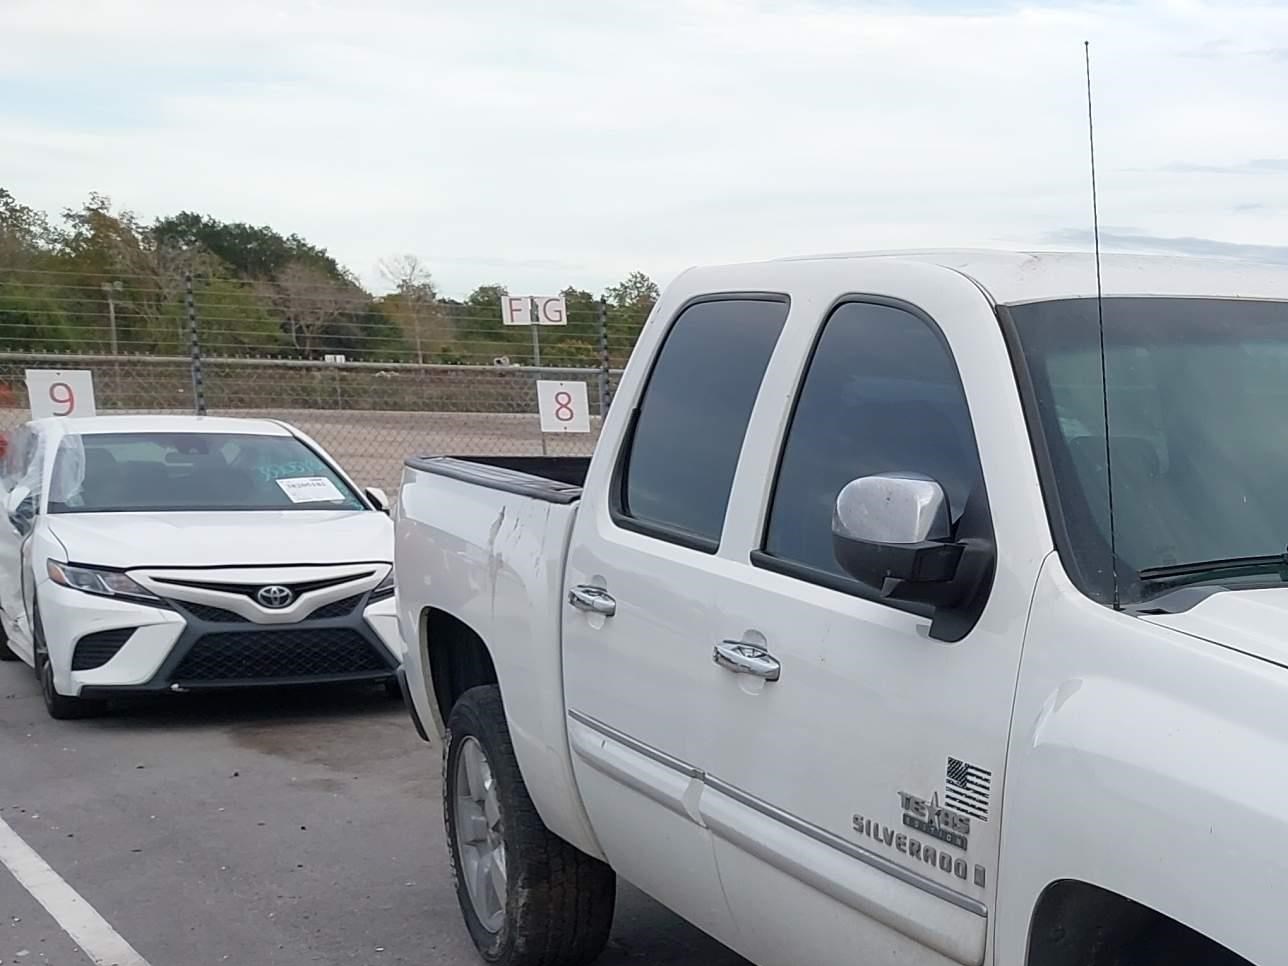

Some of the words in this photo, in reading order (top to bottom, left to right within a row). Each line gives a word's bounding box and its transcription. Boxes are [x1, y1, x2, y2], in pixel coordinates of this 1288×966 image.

[508, 298, 522, 323] F
[543, 298, 563, 323] G
[48, 382, 76, 418] 9
[554, 391, 574, 422] 8
[852, 813, 968, 881] SILVERADO
